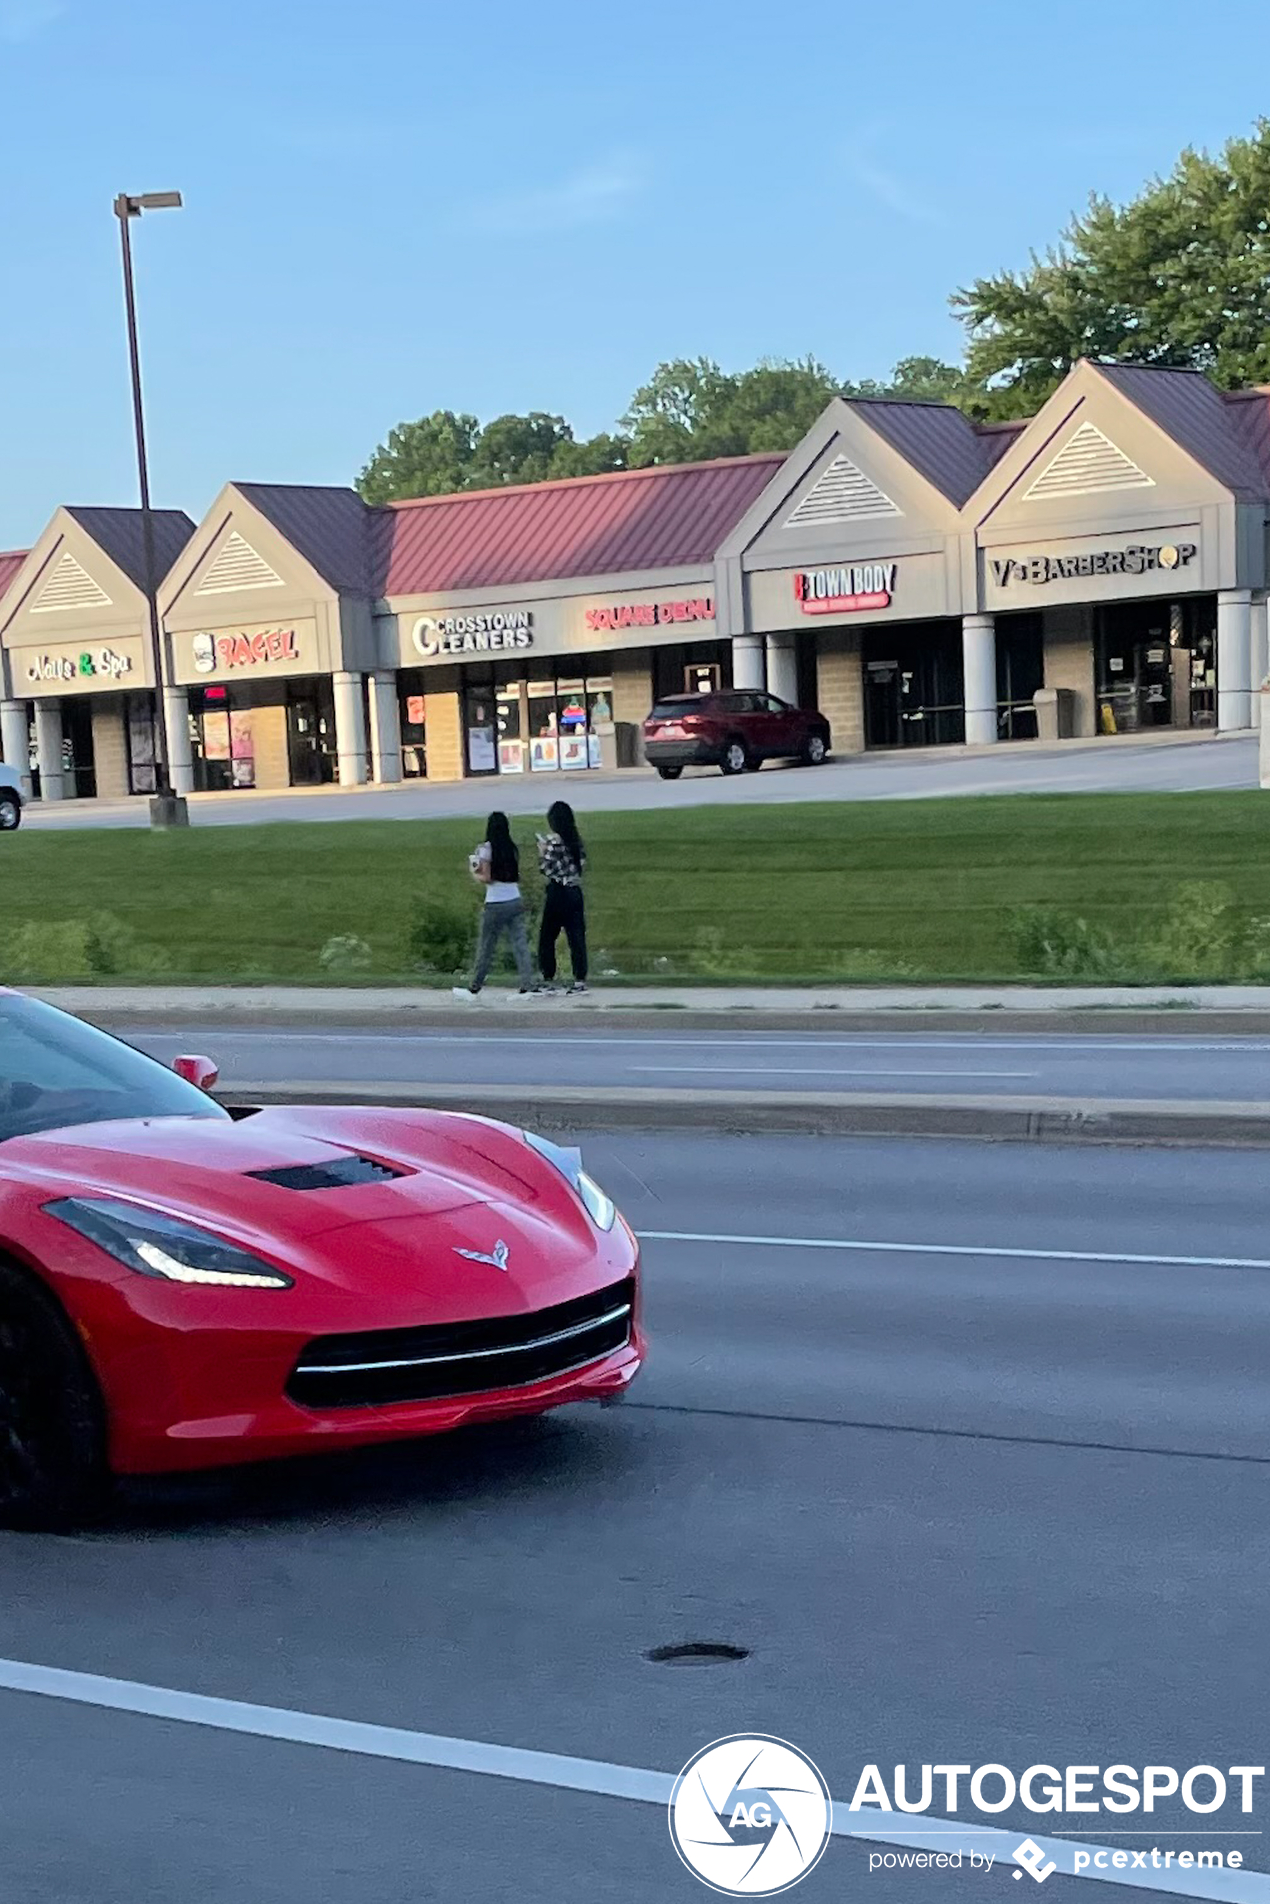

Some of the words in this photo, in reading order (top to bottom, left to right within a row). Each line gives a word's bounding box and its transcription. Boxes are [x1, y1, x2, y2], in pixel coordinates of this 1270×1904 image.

[853, 564, 894, 594] BODY
[435, 612, 532, 635] CROSSTOWN
[28, 655, 75, 681] Nails
[79, 652, 96, 677] &
[98, 647, 132, 679] Spa
